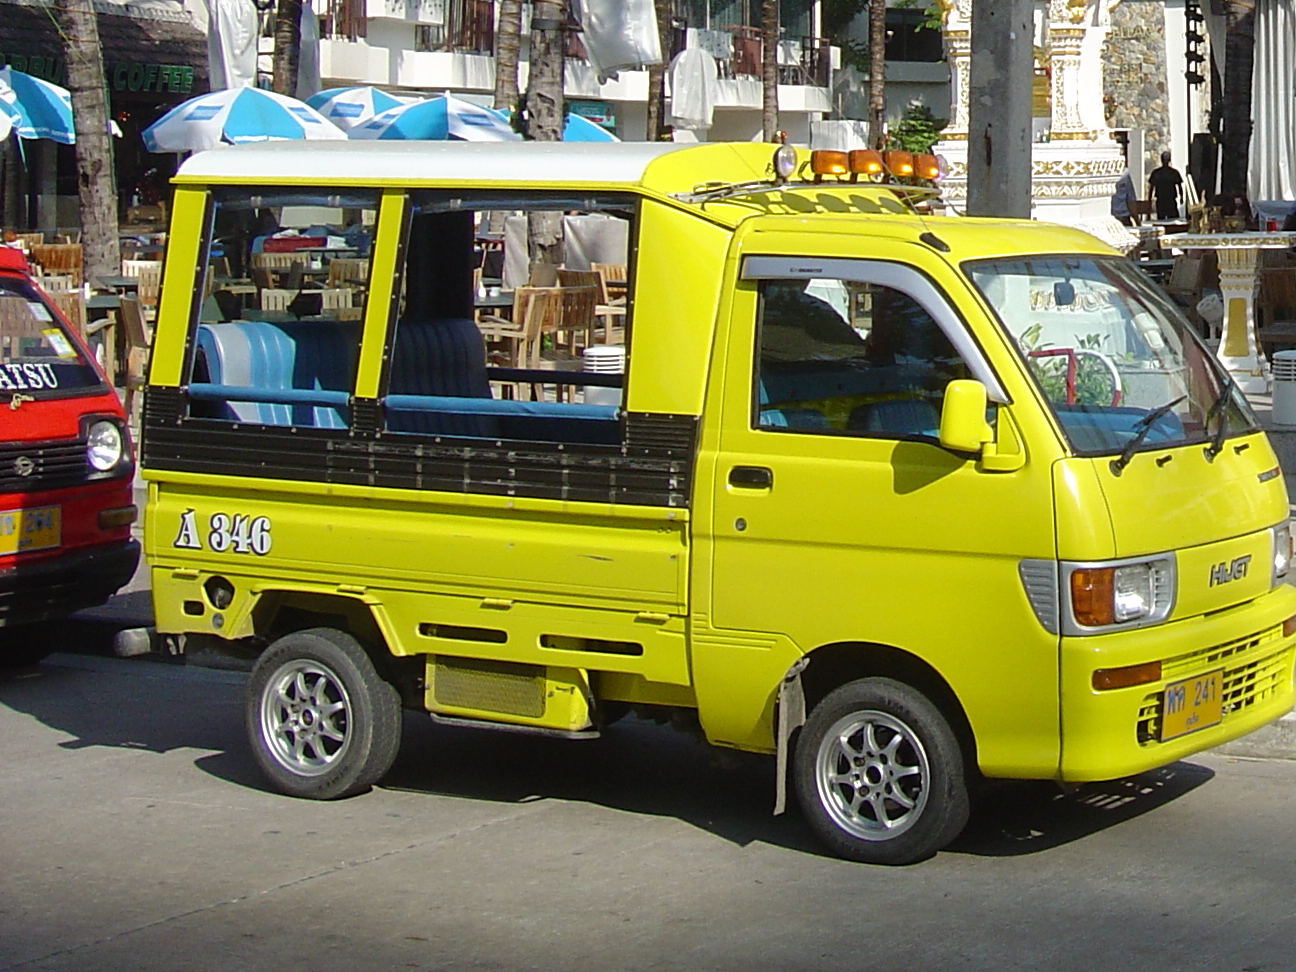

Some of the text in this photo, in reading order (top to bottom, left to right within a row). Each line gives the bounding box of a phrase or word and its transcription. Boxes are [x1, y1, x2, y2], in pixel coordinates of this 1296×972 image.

[113, 64, 193, 93] COFFEE
[0, 364, 58, 390] ATSU
[173, 508, 272, 556] A 346
